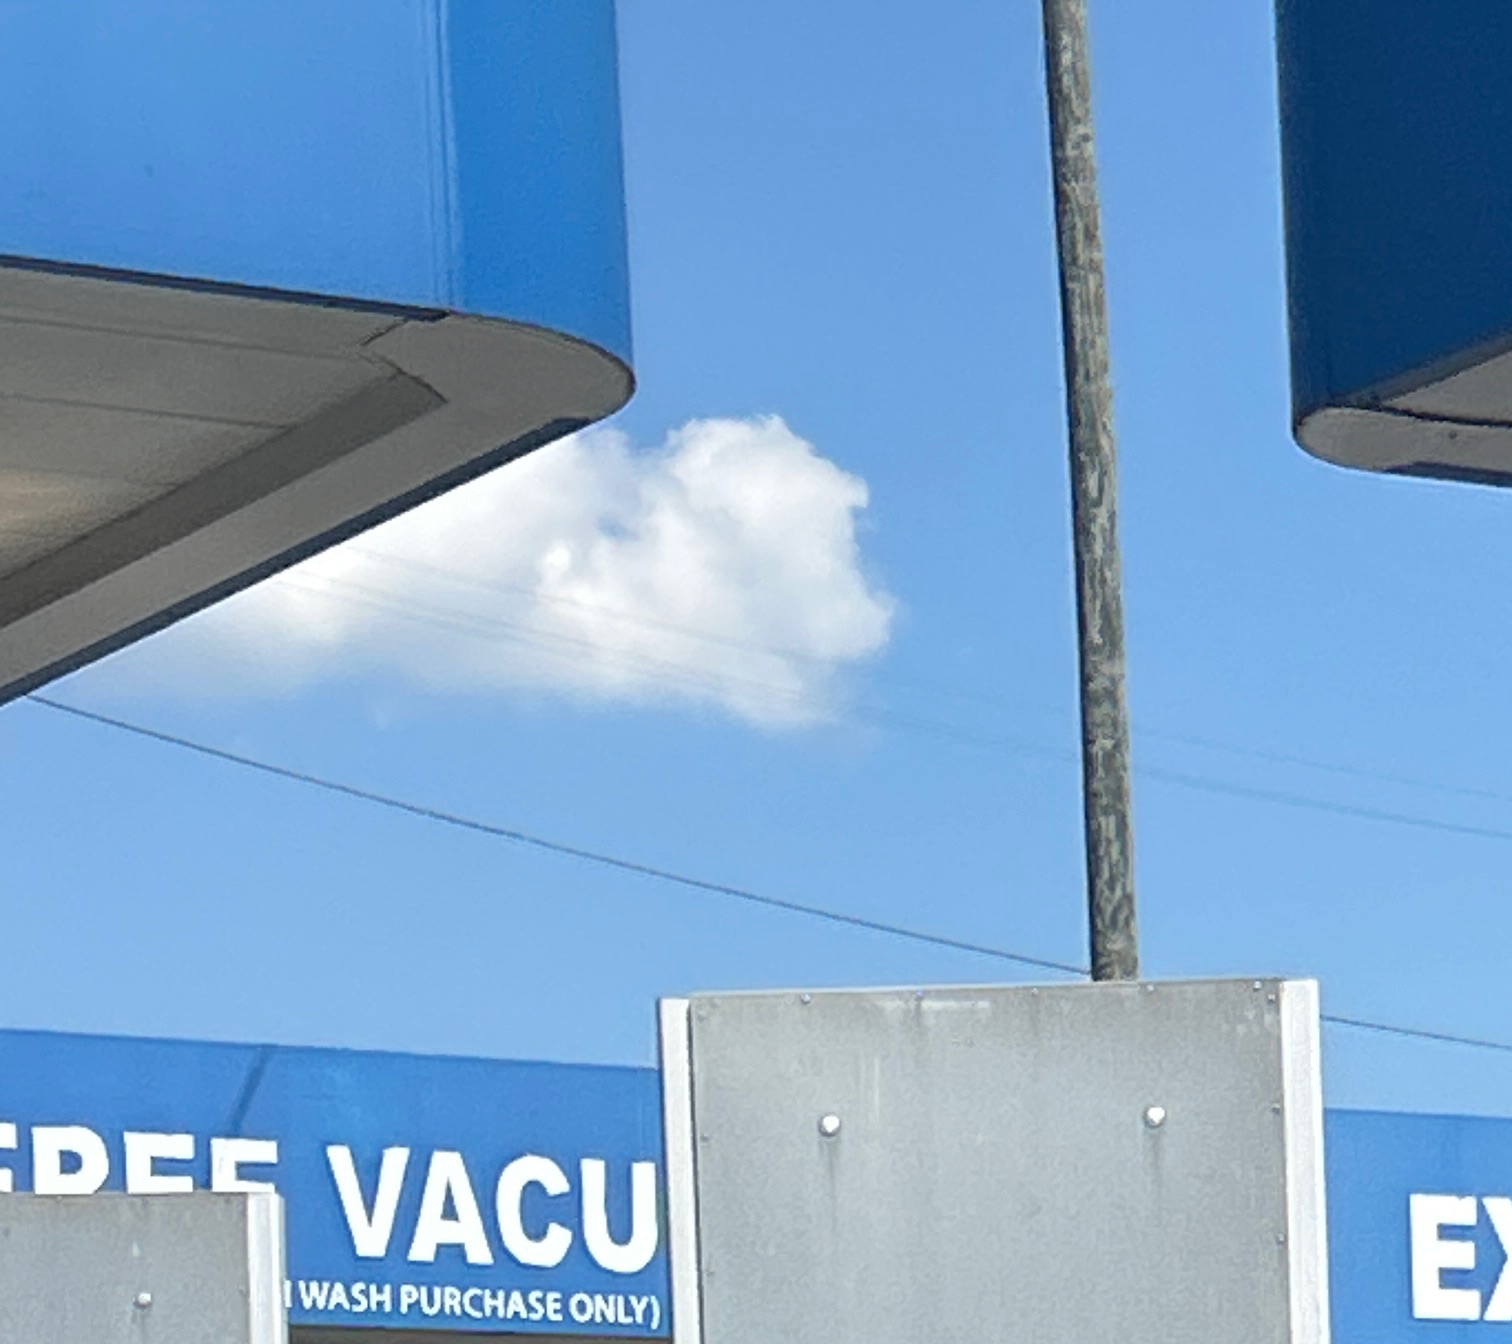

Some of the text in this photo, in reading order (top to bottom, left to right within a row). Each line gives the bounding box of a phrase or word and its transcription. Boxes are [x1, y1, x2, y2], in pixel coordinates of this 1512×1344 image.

[0, 1122, 278, 1195] REE
[298, 1279, 392, 1313] WASH
[400, 1283, 563, 1322] PURCHASE
[569, 1292, 661, 1331] ONLY)
